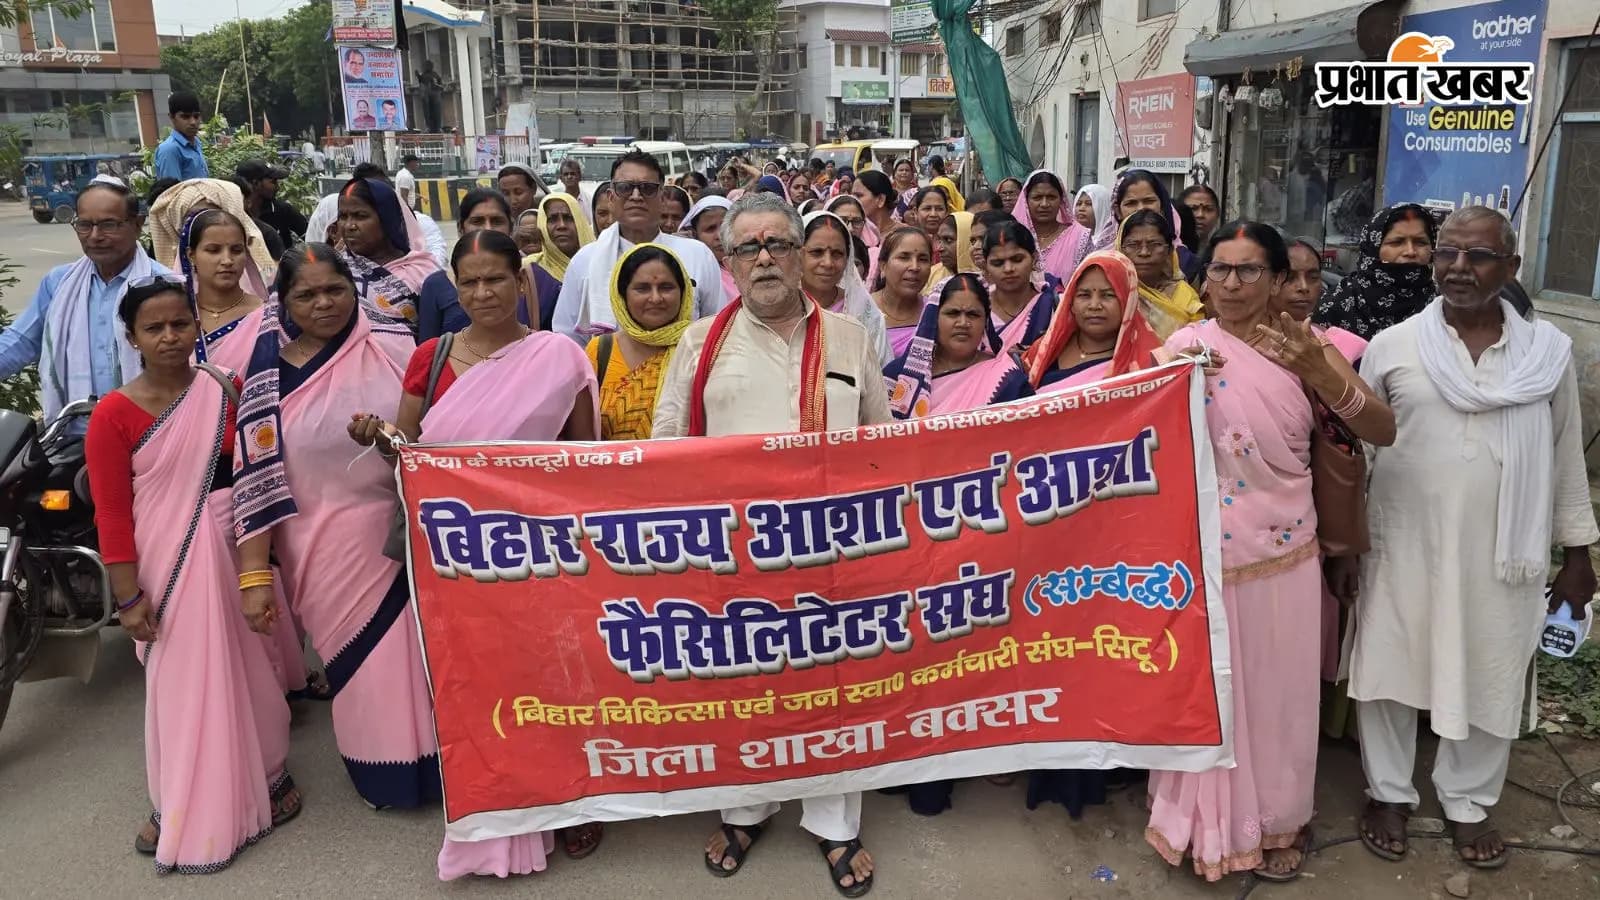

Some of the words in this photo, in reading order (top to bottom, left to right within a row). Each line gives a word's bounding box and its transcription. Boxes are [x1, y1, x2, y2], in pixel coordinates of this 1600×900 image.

[1472, 14, 1536, 40] brother
[50, 47, 102, 67] Plaza
[1480, 41, 1488, 50] at
[1489, 40, 1506, 52] your
[1506, 37, 1522, 48] side
[1128, 92, 1174, 119] RHEIN
[1406, 111, 1426, 126] Use
[1429, 106, 1515, 130] Genuine
[1132, 134, 1166, 150] राइन
[1404, 132, 1512, 154] Consumables
[762, 432, 820, 451] आशा
[863, 421, 920, 441] आशा
[466, 453, 488, 468] के
[574, 452, 612, 466] एक
[619, 448, 644, 465] हो
[418, 498, 588, 583] बिहार
[583, 504, 738, 575] राज्य
[747, 484, 910, 572] आशा
[914, 451, 1011, 542] एवं
[1015, 426, 1159, 526] आशा
[597, 592, 914, 682] फैसिलिटेटर
[916, 562, 1015, 642] संघ
[1023, 559, 1195, 616] (सम्बद्ध)
[599, 694, 726, 726] चिकित्सा
[731, 689, 777, 719] एवं
[780, 686, 839, 712] जन
[911, 636, 1020, 687] कर्मचारी
[581, 737, 717, 777] जिला
